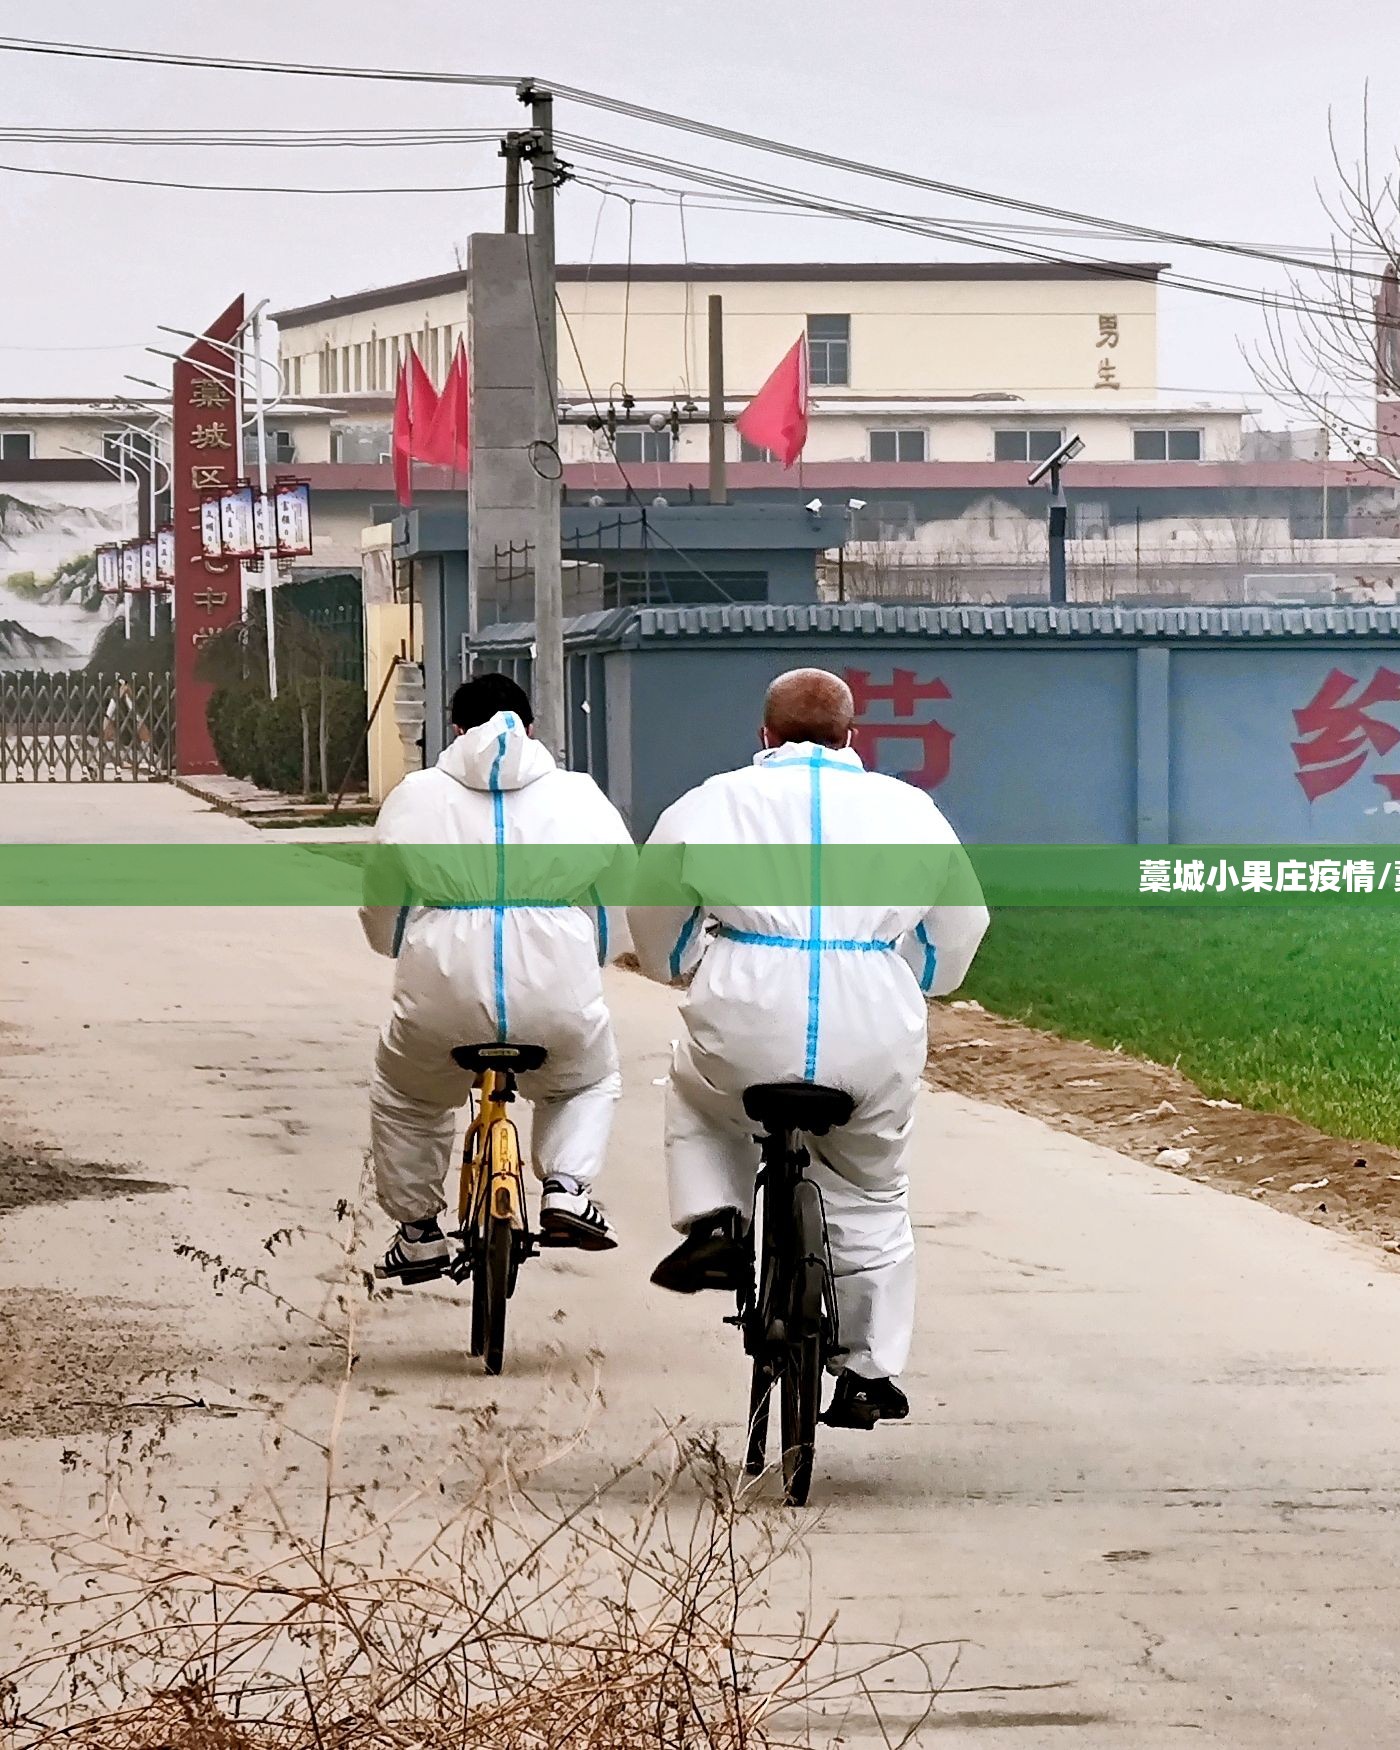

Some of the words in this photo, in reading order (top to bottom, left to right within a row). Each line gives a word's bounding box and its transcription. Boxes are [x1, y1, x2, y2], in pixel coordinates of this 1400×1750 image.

[1095, 313, 1119, 390] 男生
[189, 378, 232, 652] 藁城区中
